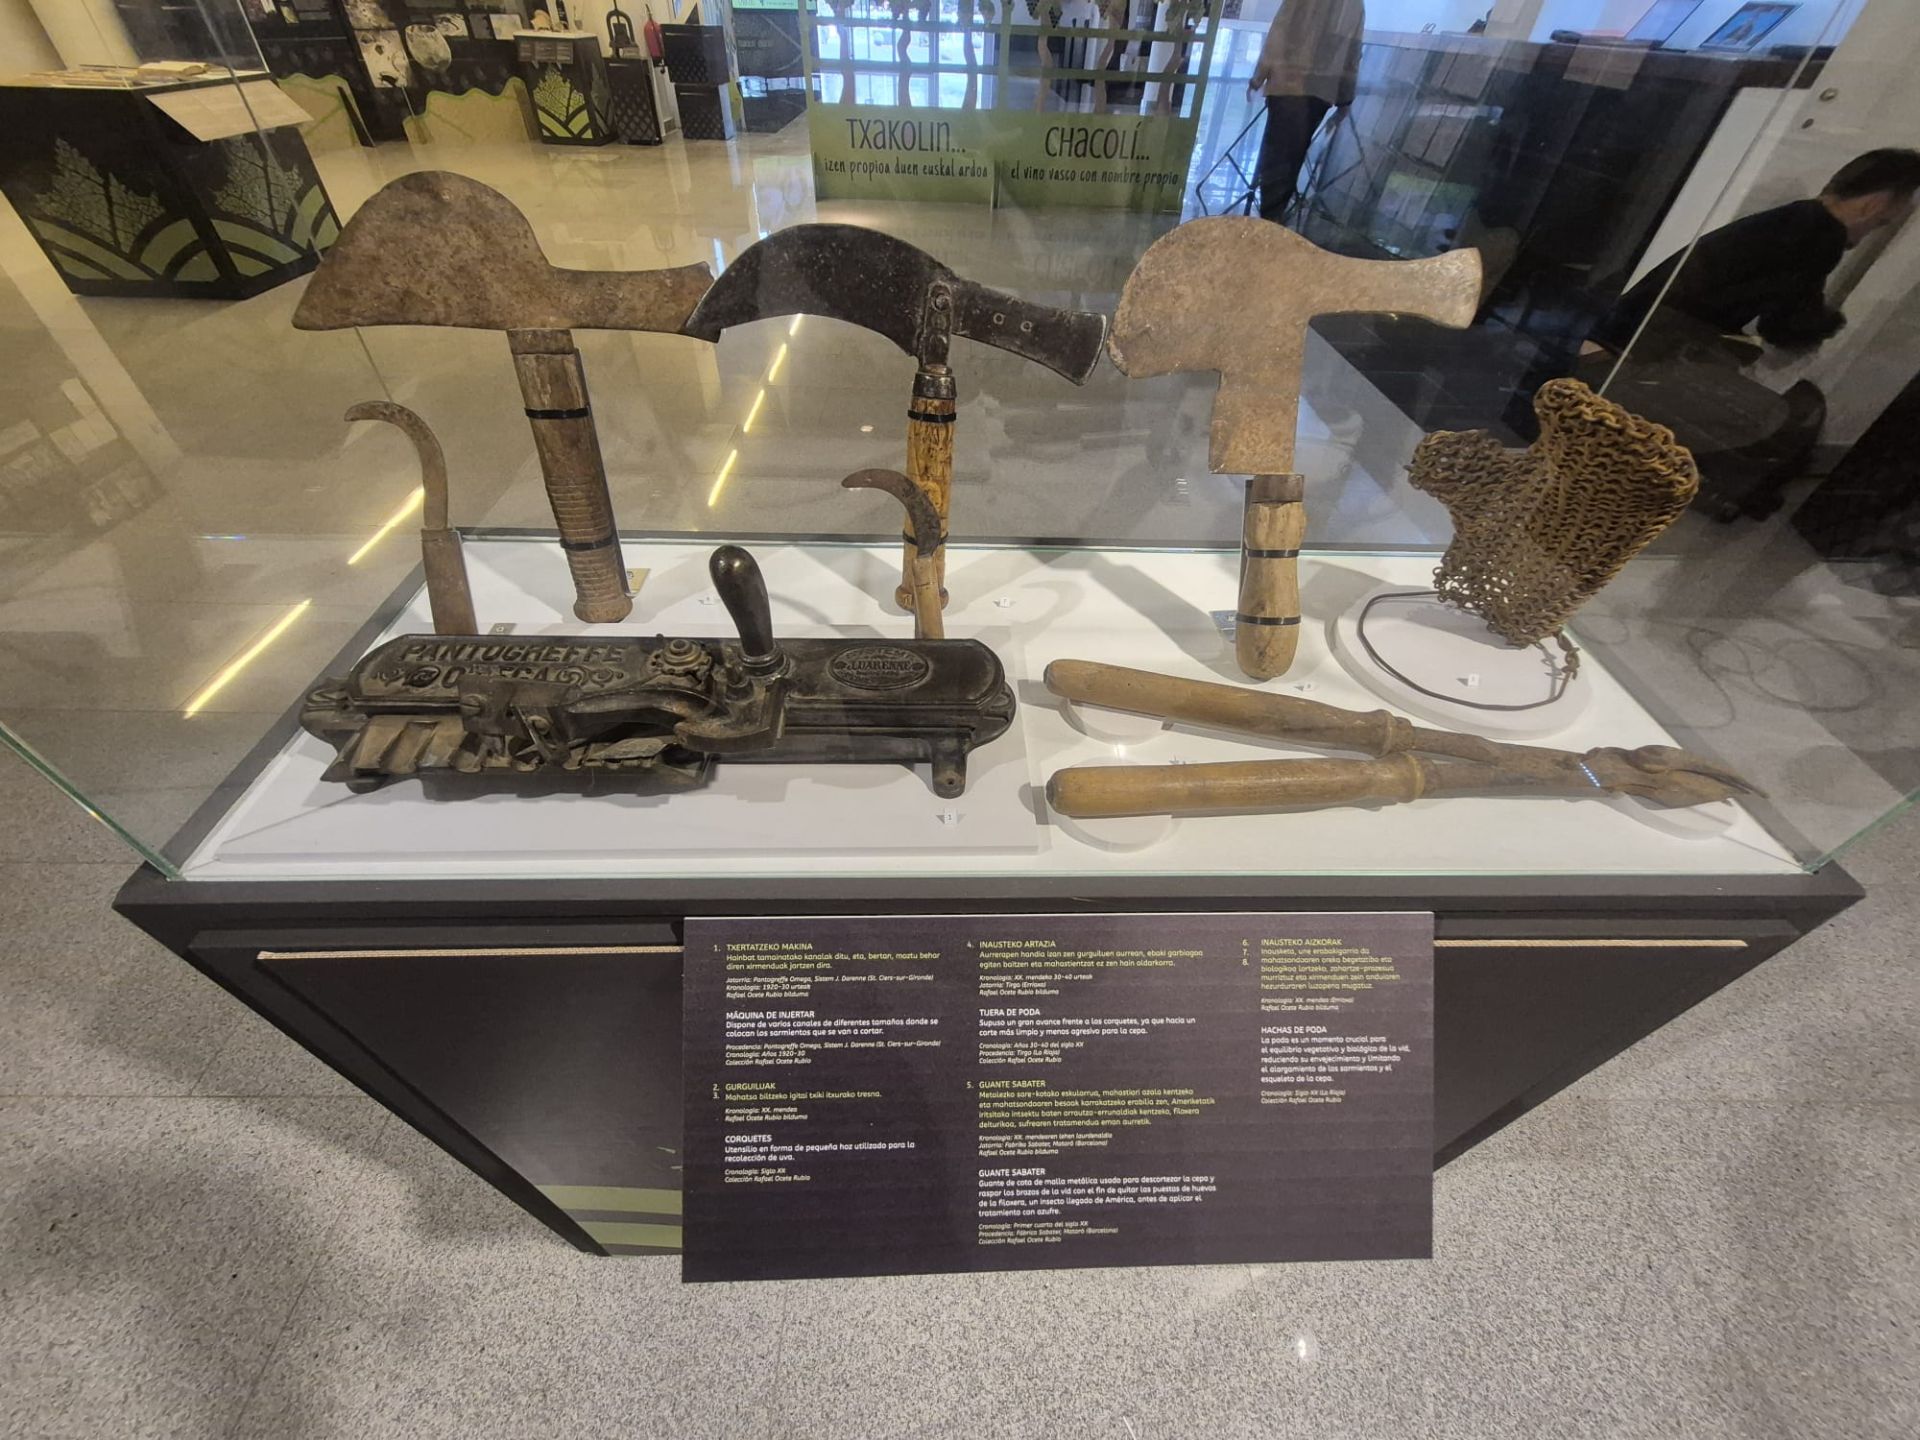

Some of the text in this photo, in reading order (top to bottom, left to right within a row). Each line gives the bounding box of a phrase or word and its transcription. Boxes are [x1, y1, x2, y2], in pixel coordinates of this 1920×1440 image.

[824, 156, 988, 182] izen propioa duen euskal ardoa
[1010, 160, 1179, 193] el vino vasco con nombre propio
[713, 942, 813, 952] 1. TXERTATZEKO MAKINA
[725, 1010, 814, 1019] MÁQUINA DE INJERTAR
[979, 1007, 1041, 1016] TIJERA DE PODA
[725, 1020, 755, 1029] Dispone
[756, 1020, 766, 1028] de
[768, 1020, 791, 1030] varios
[822, 1019, 832, 1027] de
[833, 1018, 870, 1026] diferentes
[905, 1017, 928, 1025] donde
[979, 1018, 1005, 1027] Supuso
[1017, 1019, 1034, 1027] gran
[1061, 1017, 1083, 1025] frente
[1090, 1017, 1102, 1025] los
[1140, 1017, 1150, 1026] ya
[1150, 1017, 1165, 1025] que
[756, 1029, 768, 1037] los
[1015, 1028, 1038, 1036] limpio
[1039, 1029, 1044, 1037] y
[1070, 1028, 1100, 1036] agresivo
[1119, 1026, 1127, 1034] la
[1128, 1027, 1148, 1035] cepa.
[1260, 1025, 1327, 1034] HACHAS DE PODA
[966, 1079, 1046, 1089] 5. GUANTE SABATER
[724, 1134, 772, 1143] CORQUETES
[724, 1145, 757, 1153] Utensilio
[758, 1145, 768, 1153] en
[769, 1144, 793, 1152] forma
[794, 1143, 804, 1152] de
[805, 1143, 838, 1152] pequeña
[839, 1142, 853, 1150] hoz
[853, 1141, 886, 1150] utilizado
[906, 1140, 915, 1148] la
[724, 1154, 766, 1162] recolección
[767, 1153, 777, 1161] de
[978, 1168, 1045, 1176] GUANTE SABATER
[978, 1179, 1004, 1187] Guante
[1005, 1178, 1015, 1186] de
[1033, 1178, 1043, 1186] de
[1044, 1177, 1066, 1185] malla
[1066, 1176, 1098, 1185] metálica
[1099, 1176, 1121, 1184] usado
[1140, 1175, 1181, 1183] descortezar
[1191, 1175, 1209, 1183] cepa
[1209, 1175, 1215, 1183] y
[978, 1209, 1021, 1217] tratamiento
[1036, 1207, 1060, 1215] azufre.
